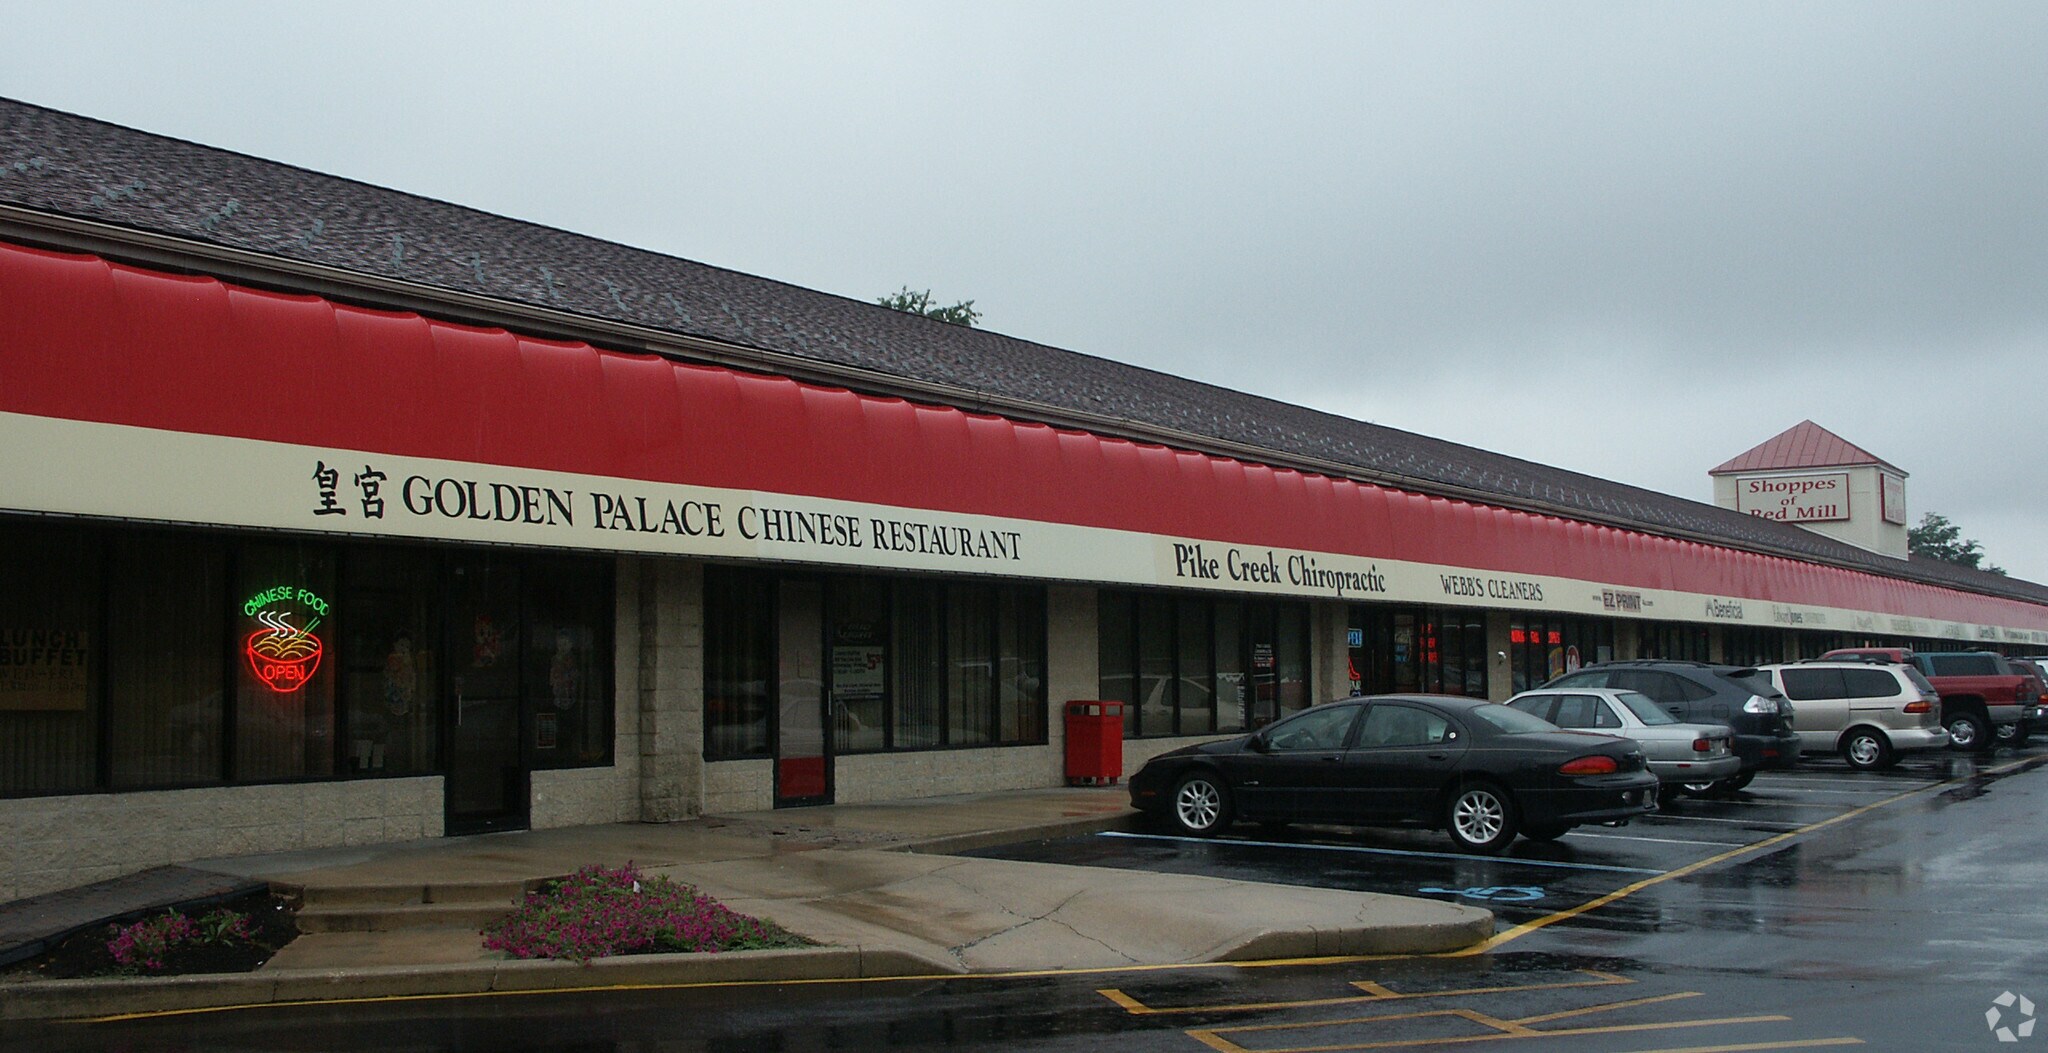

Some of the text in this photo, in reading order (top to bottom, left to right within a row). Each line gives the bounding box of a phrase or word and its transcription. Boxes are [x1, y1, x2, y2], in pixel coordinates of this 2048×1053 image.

[311, 460, 387, 519] 皇宮
[1749, 478, 1836, 494] Shoppes
[1780, 495, 1798, 506] of
[402, 475, 1021, 560] GOLDEN PALACE CHINESE RESTAURANT
[1796, 504, 1837, 519] Mill
[1173, 543, 1386, 597] Pike Creek Chiropractic
[1440, 574, 1543, 602] WEBB'S CLEANERS
[244, 586, 330, 616] CHINESE FOOD
[1603, 592, 1615, 608] EZ
[1615, 593, 1641, 609] PRINT
[1713, 599, 1743, 619] Beneficial
[264, 664, 305, 680] OPEN
